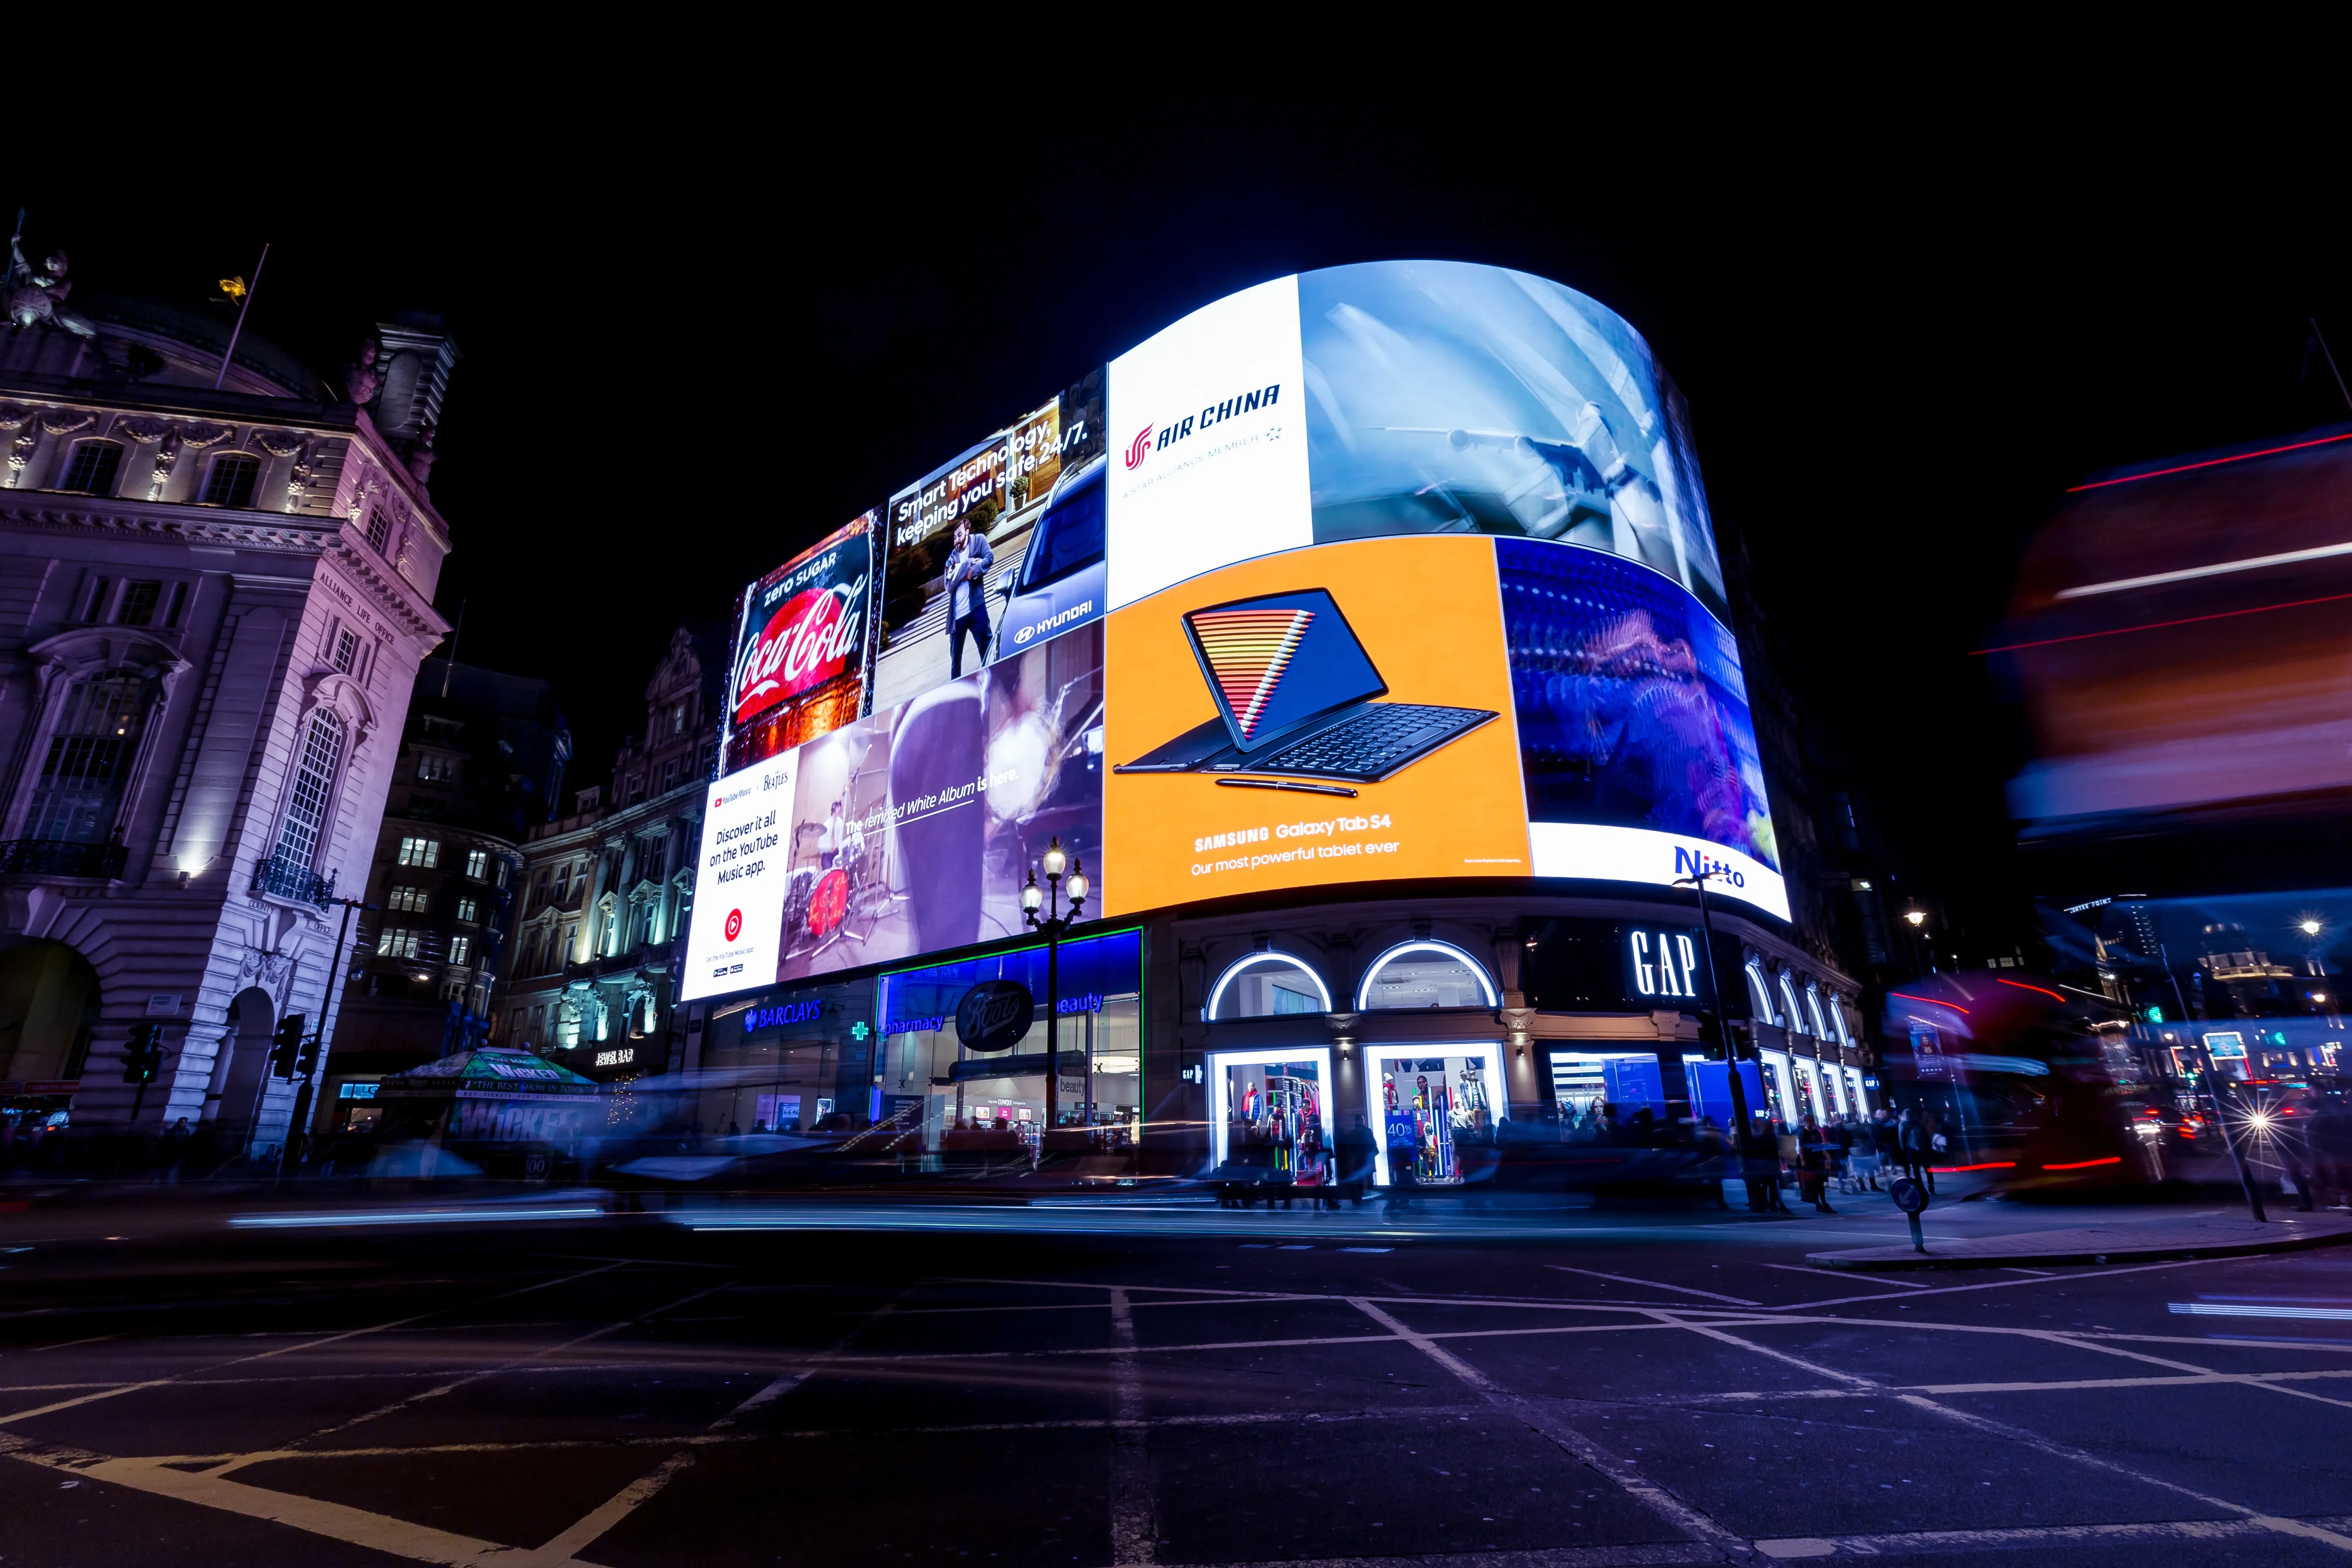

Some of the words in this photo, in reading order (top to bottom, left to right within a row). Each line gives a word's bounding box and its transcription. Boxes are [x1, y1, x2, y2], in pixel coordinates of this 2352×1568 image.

[1156, 415, 1194, 452] AIR
[1199, 384, 1280, 430] CHINA
[896, 499, 958, 546] keeping
[961, 483, 992, 514] you
[995, 454, 1035, 489] safe
[1038, 420, 1088, 465] 24/7.
[898, 480, 946, 521] Smart
[949, 420, 1052, 493] Technology,
[1123, 491, 1129, 499] A
[1130, 478, 1155, 495] STAR
[1157, 455, 1206, 482] ALLIANCE
[1208, 434, 1259, 458] MEMBER
[764, 576, 794, 608] zero
[796, 551, 837, 588] SUGAR
[319, 573, 353, 608] ALLIANCE
[356, 604, 371, 624] LIFE
[374, 622, 395, 645] OFFICE
[1036, 600, 1092, 635] HYUNDAI
[731, 572, 869, 714] Coca-Cola
[723, 792, 738, 804] YouTube
[738, 787, 752, 799] Music
[763, 772, 788, 791] BEATLES
[845, 819, 863, 836] The
[864, 802, 905, 830] remixed
[907, 794, 937, 818] White
[938, 781, 975, 805] Album
[977, 776, 987, 792] is
[989, 768, 1019, 788] here.
[716, 817, 754, 846] Discover
[755, 815, 763, 830] it
[764, 810, 776, 827] all
[1194, 826, 1270, 853] SAMSUNG
[1275, 820, 1337, 838] Galaxy
[1337, 816, 1369, 832] Tab
[1370, 813, 1392, 829] S4
[710, 852, 721, 868] on
[722, 846, 738, 864] the
[739, 834, 778, 858] YouTube
[1216, 856, 1249, 872] most
[1251, 846, 1315, 870] powerful
[1318, 842, 1363, 859] tablet
[1365, 840, 1400, 854] ever
[1674, 845, 1745, 888] Nitto
[717, 863, 744, 885] Music
[745, 861, 766, 878] app.
[1631, 931, 1696, 997] GAP
[758, 999, 822, 1028] BARCLAYS
[961, 990, 1021, 1040] Boots
[1057, 992, 1103, 1013] eauty
[884, 1015, 944, 1038] pharmacy
[488, 1063, 562, 1079] WICKED
[595, 1050, 617, 1066] JEWEL
[617, 1049, 634, 1064] BAR
[1183, 1069, 1194, 1079] GAP
[473, 1081, 495, 1089] "THE
[1060, 1078, 1086, 1096] beauty
[1387, 1123, 1412, 1137] 40%
